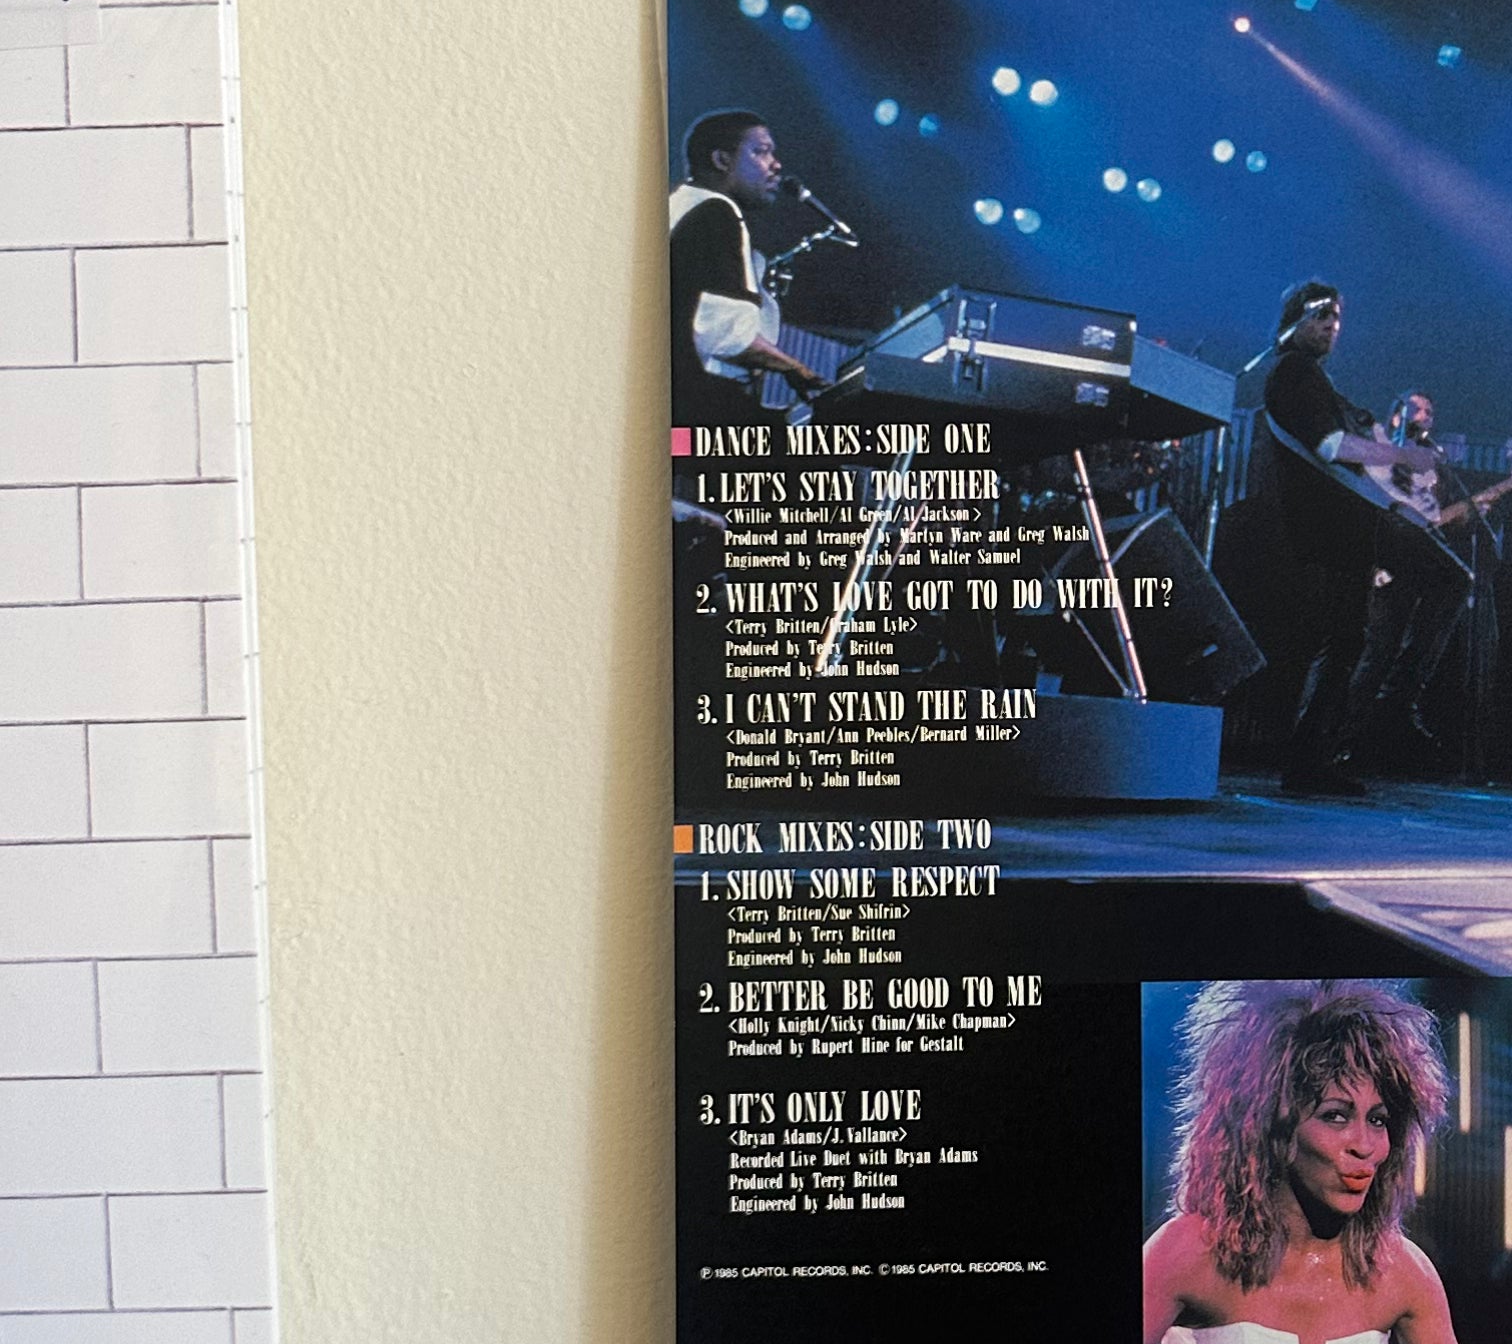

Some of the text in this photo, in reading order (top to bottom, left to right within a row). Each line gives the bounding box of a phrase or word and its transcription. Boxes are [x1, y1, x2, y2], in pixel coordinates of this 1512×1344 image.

[696, 426, 771, 457] DANCE
[944, 423, 991, 454] ONE
[800, 471, 857, 502] STAY
[871, 469, 1000, 501] TOGETHER
[724, 529, 777, 546] Produced
[785, 529, 807, 545] and
[816, 528, 869, 547] Arranged
[900, 527, 943, 546] Martyn
[951, 527, 982, 544] Ware
[989, 527, 1010, 543] and
[1018, 526, 1045, 545] Greg
[1053, 525, 1089, 542] Walsh
[696, 584, 717, 613] 2.
[726, 581, 819, 613] WHAT'S
[833, 580, 893, 612] LOVE
[907, 580, 953, 610] GOT
[967, 579, 997, 610] TO
[1013, 579, 1043, 609] DO
[1057, 578, 1120, 609] WITH
[697, 688, 1037, 724] 3. I CAN'T STAND THE RAIN
[727, 748, 894, 769] Produced by Terry Britten
[727, 770, 900, 792] Engineered by John Hudson
[699, 823, 763, 854] ROCK
[937, 818, 991, 850] TWO
[701, 864, 1000, 901] 1. SHOW SOME RESPECT
[728, 925, 896, 946] Produced by Terry Britten
[728, 947, 902, 969] Engineered by John Hudson
[699, 975, 1042, 1013] 2. BETTER BE GOOD TO ME
[728, 1035, 964, 1058] Produced by Rupert Hine for Gestalt
[700, 1089, 922, 1125] 3. IT'S ONLY LOVE
[730, 1146, 979, 1169] Recorded Live Duet with Bryan Adams
[729, 1171, 898, 1193] Produced by Terry Britten
[730, 1192, 905, 1215] Engineered by John Hudson
[742, 1266, 789, 1278] CAPITOL
[852, 1265, 874, 1275] INC.
[918, 1262, 966, 1274] CAPITOL
